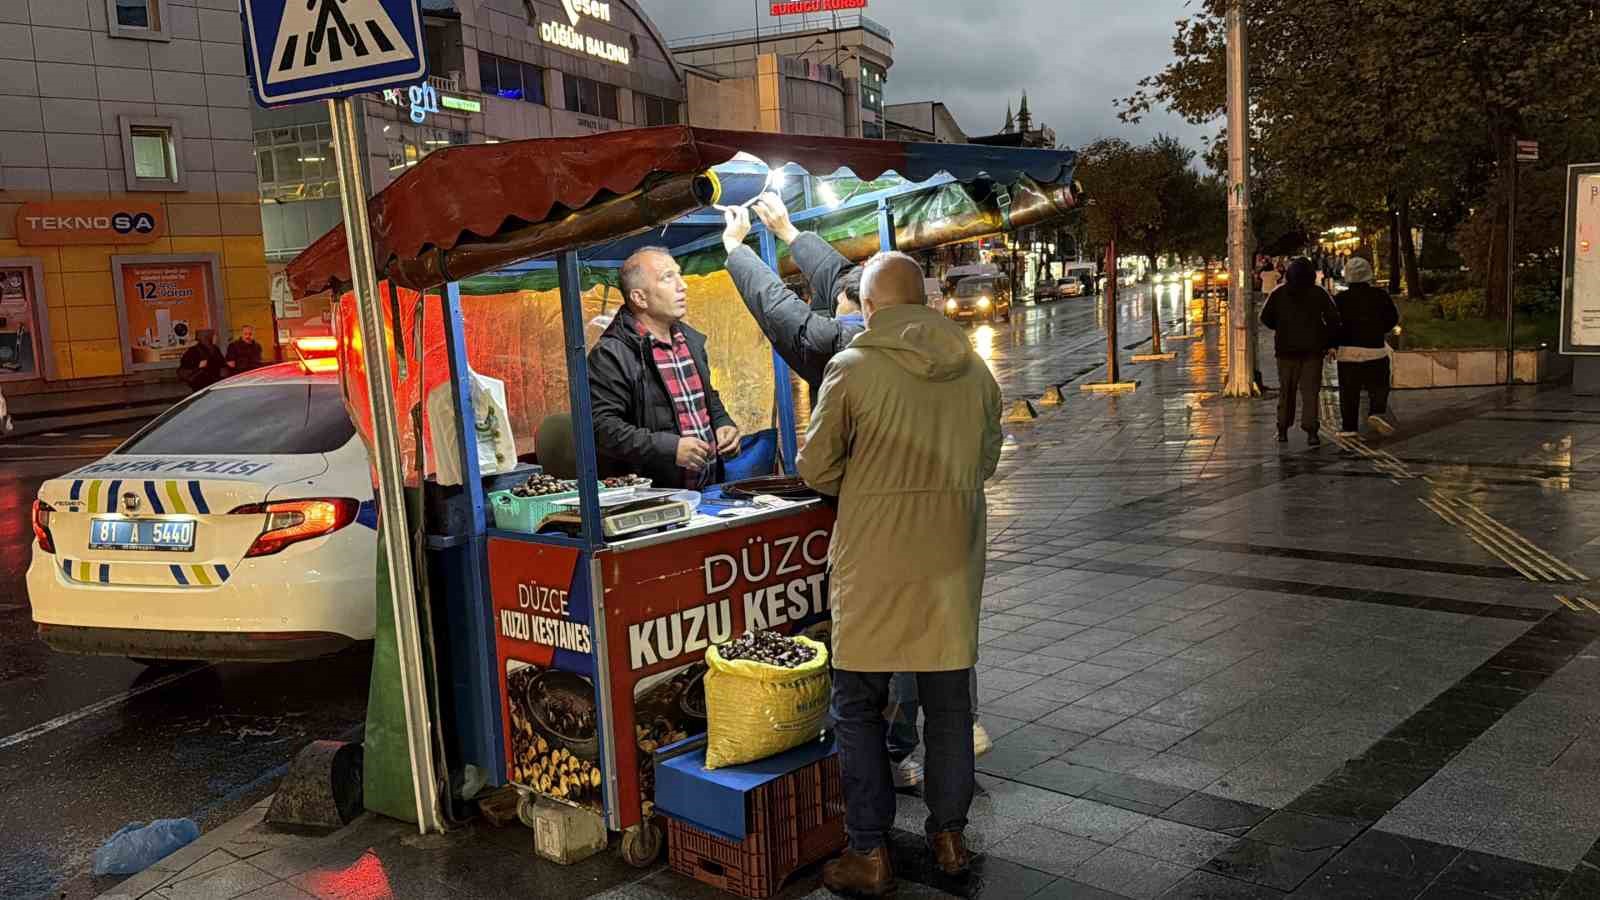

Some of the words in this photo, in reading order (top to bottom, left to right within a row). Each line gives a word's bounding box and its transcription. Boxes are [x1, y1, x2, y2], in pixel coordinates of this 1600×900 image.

[25, 214, 154, 231] TEKNOSA
[136, 282, 157, 299] 12
[100, 521, 116, 542] 81
[130, 522, 138, 543] A
[152, 521, 191, 543] 5440
[704, 529, 830, 595] DÜZC
[518, 580, 570, 616] DÜZCE
[501, 609, 530, 641] KUZU
[629, 599, 731, 670] KUZU
